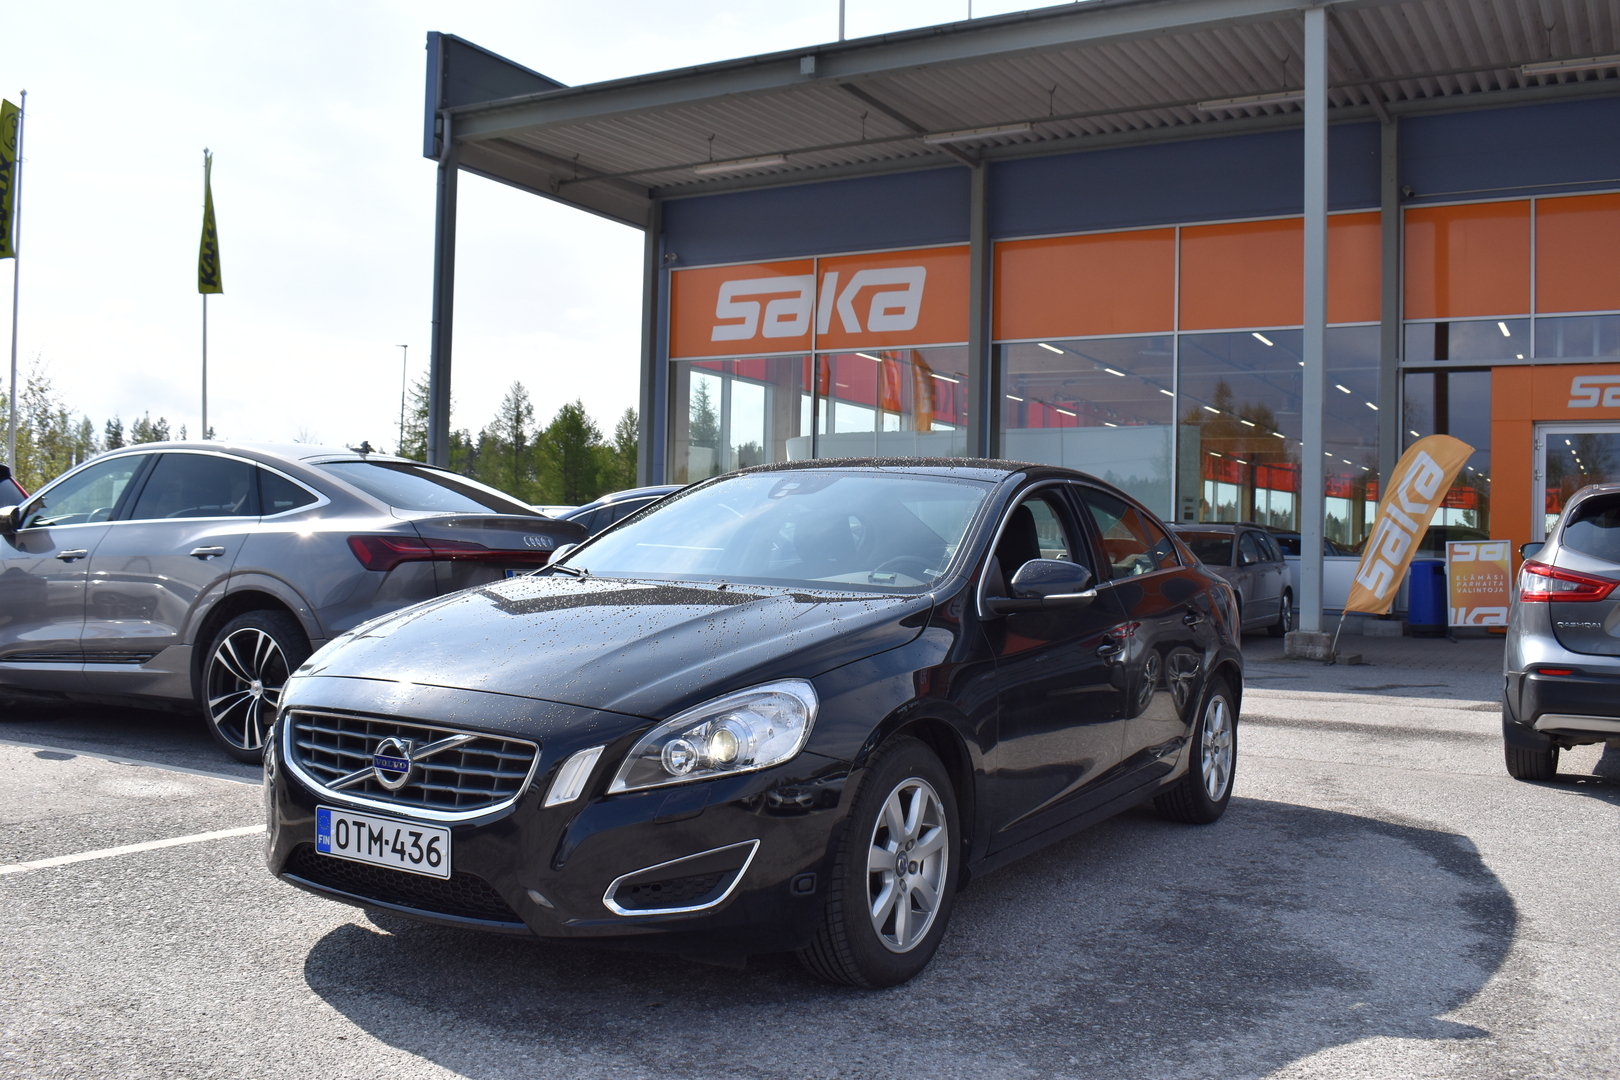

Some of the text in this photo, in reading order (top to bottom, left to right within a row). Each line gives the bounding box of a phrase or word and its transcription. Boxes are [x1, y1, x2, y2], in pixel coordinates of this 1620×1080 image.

[376, 759, 407, 769] VOLVO
[318, 834, 330, 845] FIN
[336, 818, 441, 867] OTM-436
